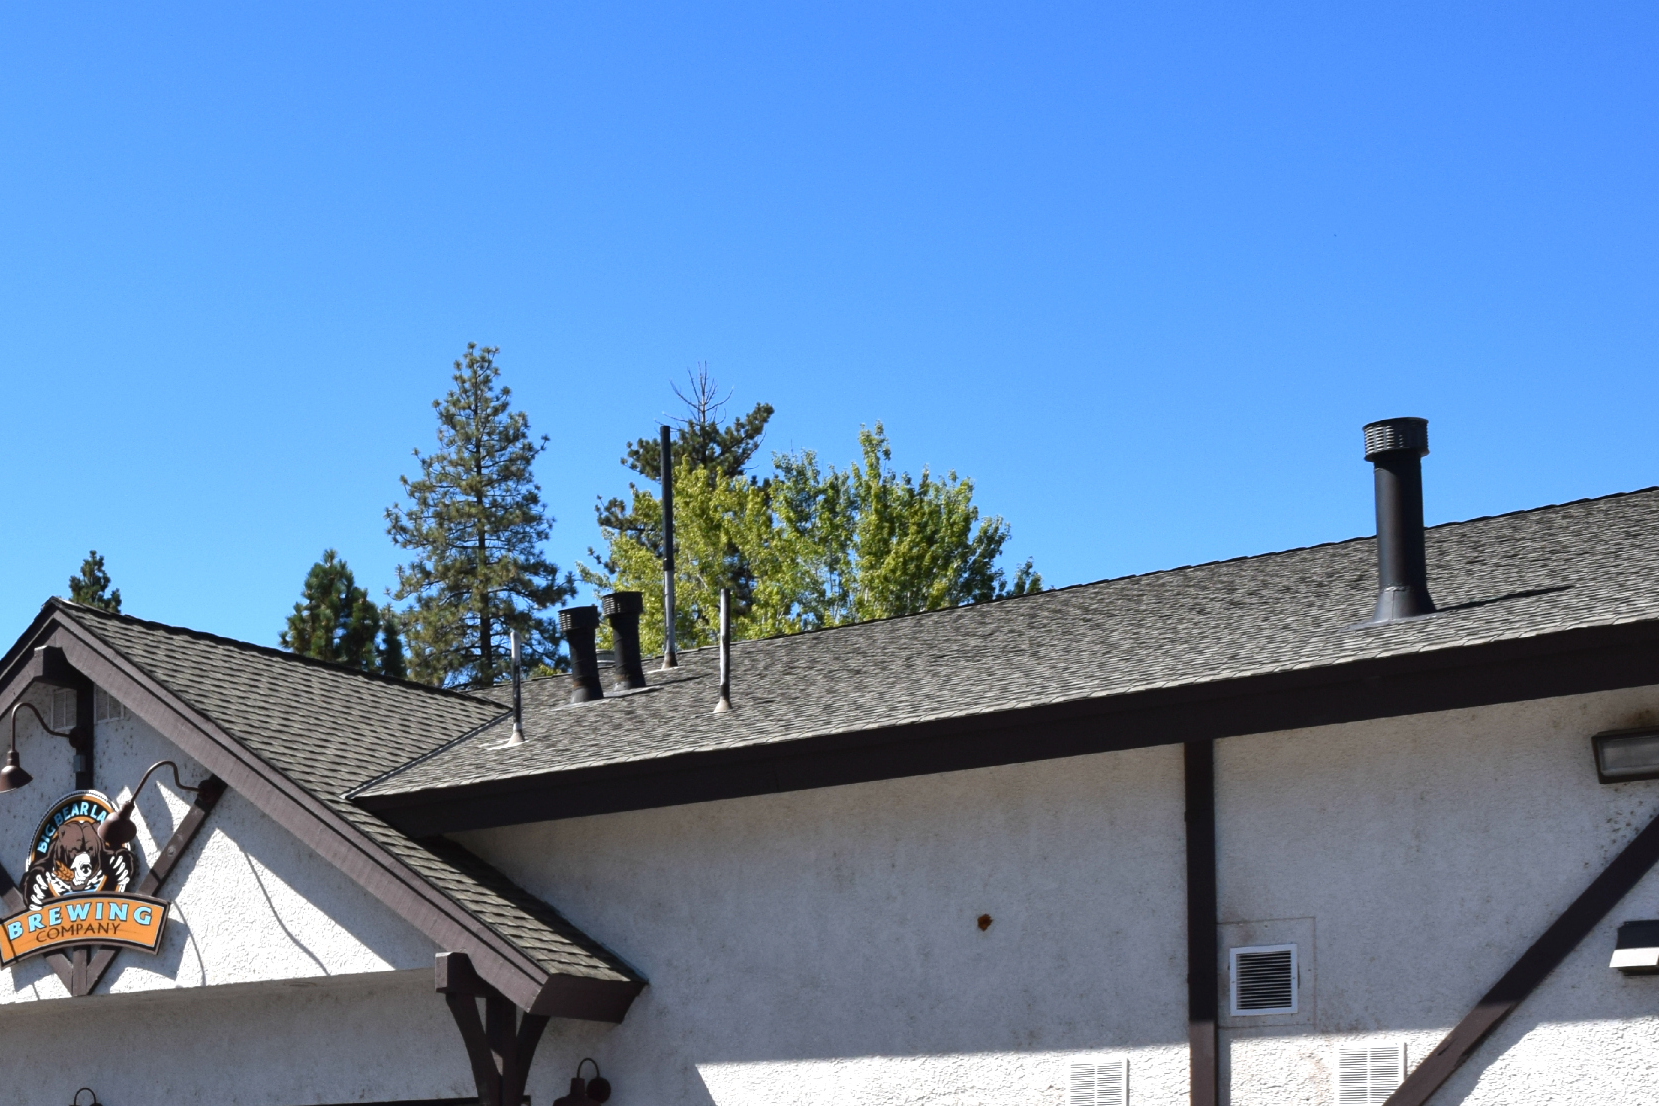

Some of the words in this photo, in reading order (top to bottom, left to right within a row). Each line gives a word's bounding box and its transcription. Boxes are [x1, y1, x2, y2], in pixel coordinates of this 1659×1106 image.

[37, 824, 56, 853] BIG
[53, 801, 90, 826] BEAR
[90, 804, 108, 825] LA
[6, 901, 153, 940] BREWING
[36, 922, 121, 943] COMPANY
